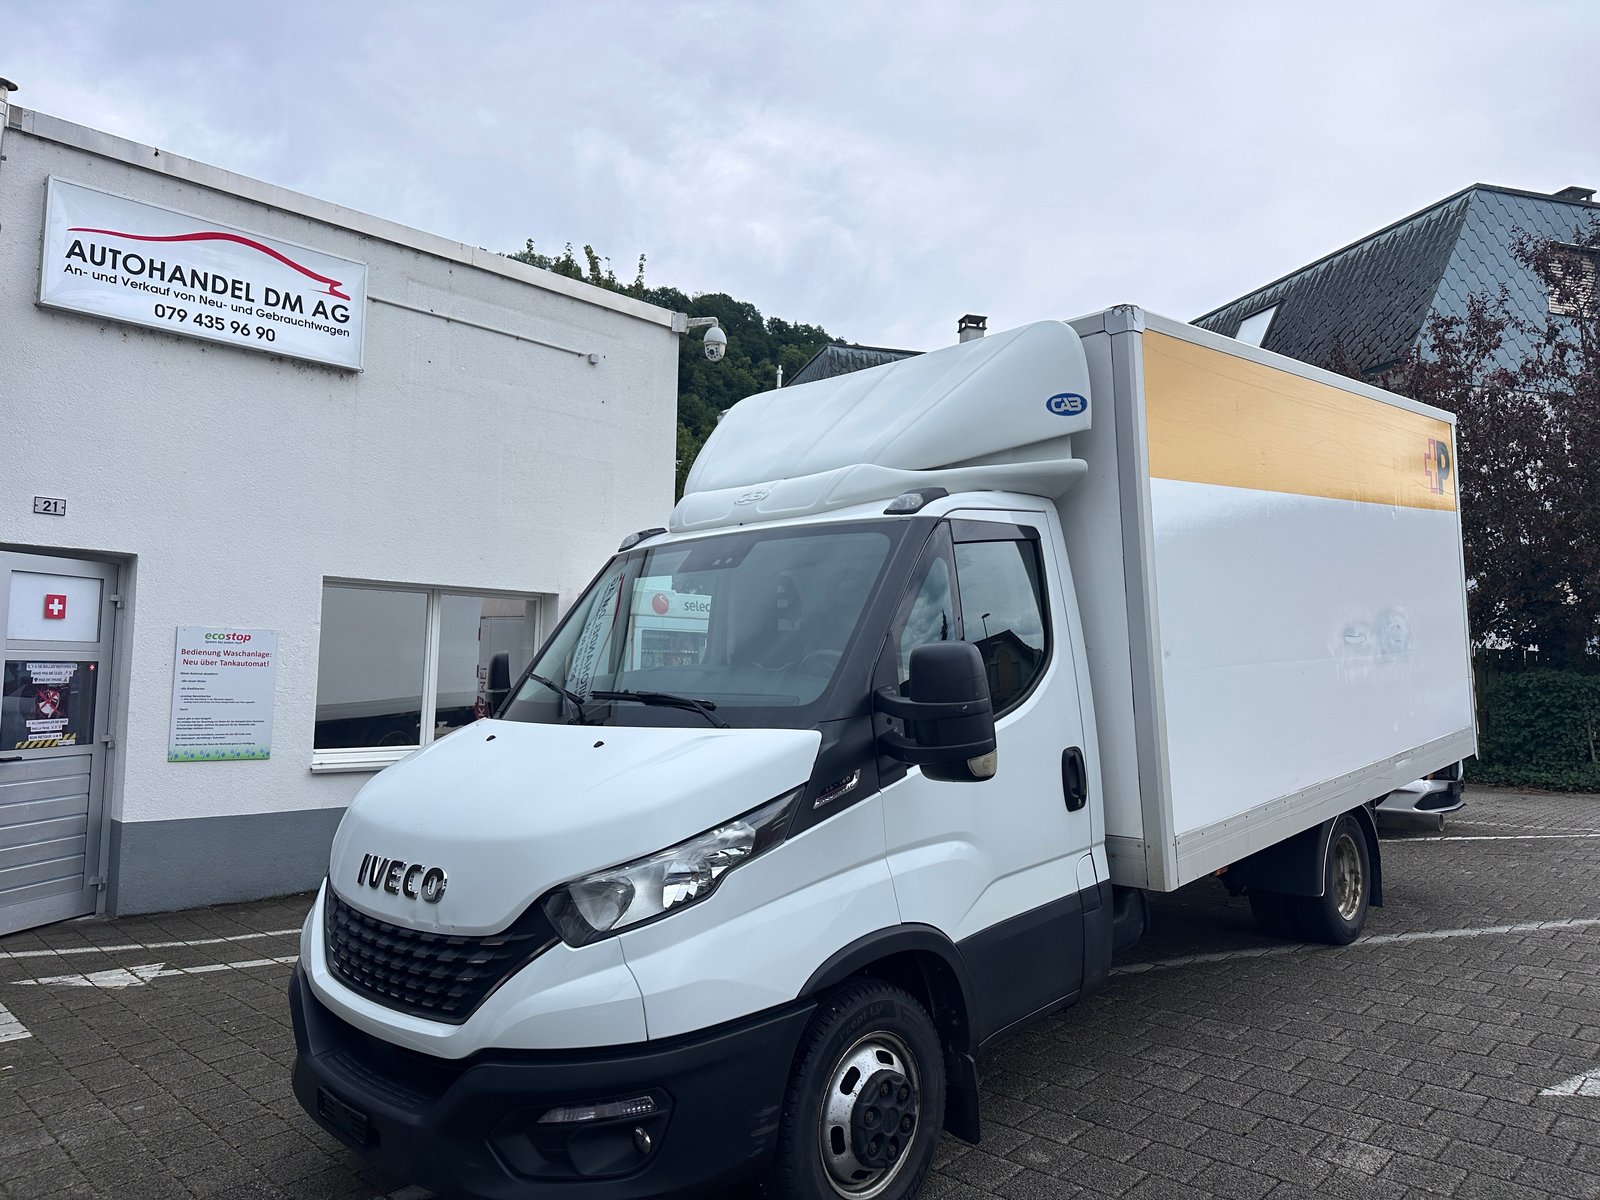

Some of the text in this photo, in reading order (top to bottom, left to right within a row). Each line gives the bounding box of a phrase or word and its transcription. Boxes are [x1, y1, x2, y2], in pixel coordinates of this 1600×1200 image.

[65, 239, 350, 324] AUTOHANDEL DM AG
[63, 263, 350, 337] An- und Verkauf von Neu- und Gebrauchtwagen
[154, 303, 276, 342] 079 435 96 90
[42, 500, 58, 512] 21
[204, 632, 252, 644] ecostop
[181, 648, 273, 659] Bedienung Waschanlage:
[182, 658, 270, 668] Neu über Tankautomat!
[357, 853, 448, 904] IVECO
